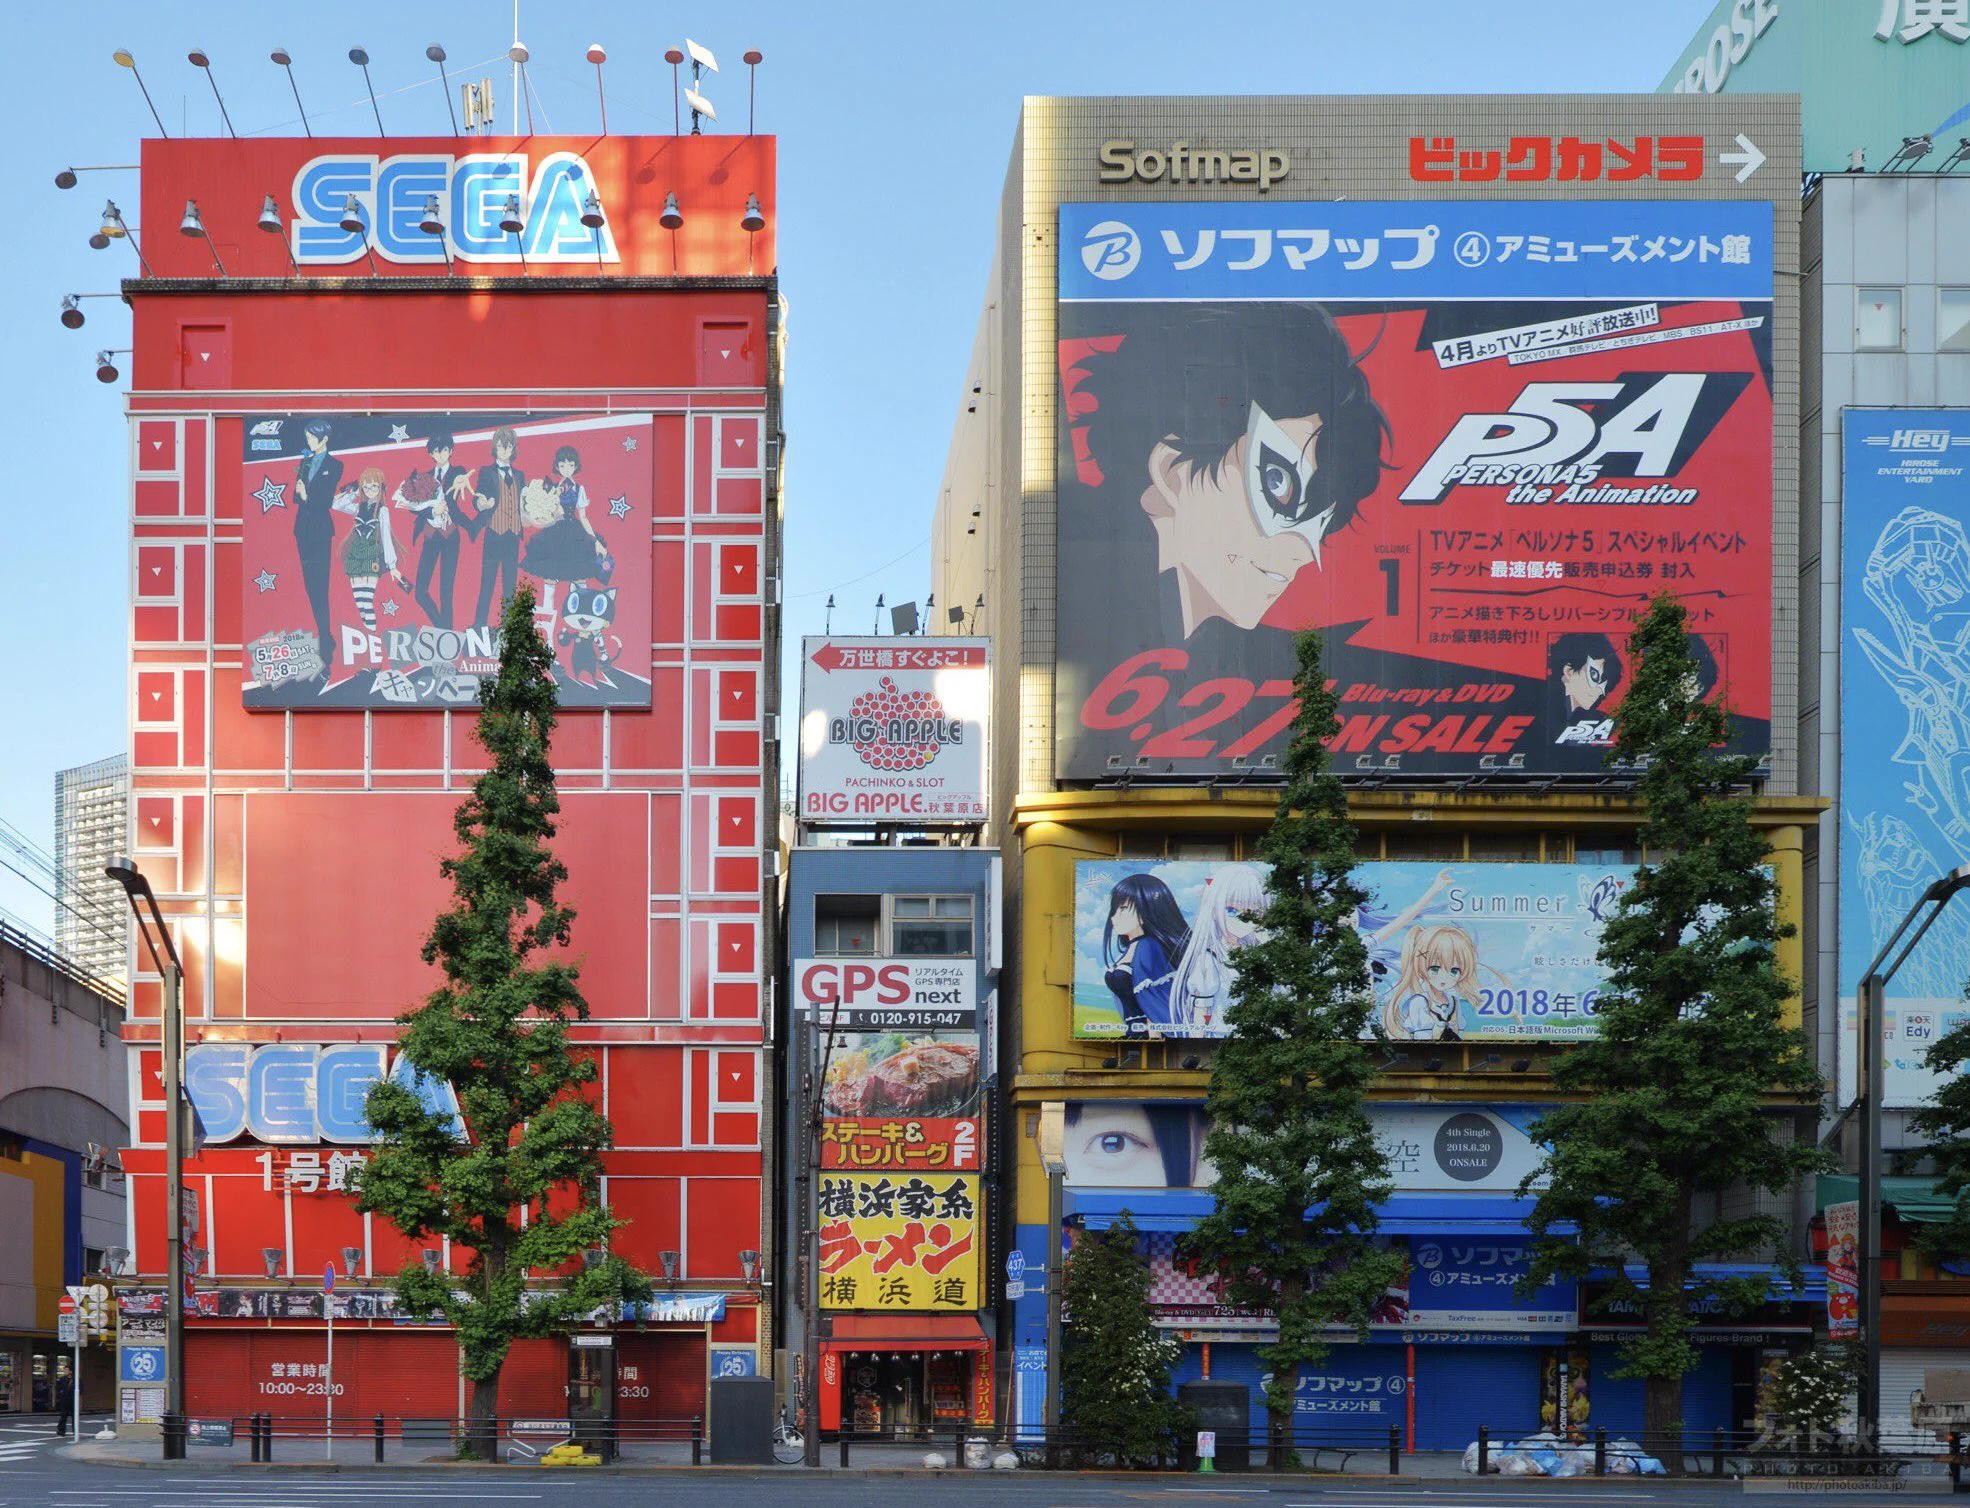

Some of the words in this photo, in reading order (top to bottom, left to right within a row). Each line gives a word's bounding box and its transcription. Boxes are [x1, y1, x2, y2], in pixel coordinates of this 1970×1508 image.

[1100, 140, 1291, 192] Sofmap
[1409, 137, 1704, 181] ビックカメラ
[291, 154, 620, 264] SEGA
[1160, 225, 1440, 270] ソフマップ
[1514, 350, 1546, 362] TOKYO
[1663, 329, 1683, 340] MBS
[1690, 324, 1714, 337] BS11
[1720, 320, 1743, 332] AT-X
[1889, 429, 1951, 453] Hey
[1877, 467, 1964, 476] ENTERTAINMENT
[1901, 459, 1941, 467] HIROSE
[1440, 463, 1605, 486] PERSONA5
[1903, 476, 1934, 484] YARD
[1504, 483, 1548, 504] the
[1562, 482, 1699, 506] Animation
[1373, 544, 1411, 554] VOLUME
[1661, 561, 1695, 579] 封入
[1379, 558, 1400, 617] 1
[433, 661, 456, 676] the
[459, 659, 500, 673] Anima
[839, 649, 969, 668] 万世橋すぐよこ!
[382, 671, 478, 700] キャンペー
[1080, 647, 1338, 759] 6.27
[829, 717, 878, 744] BIG
[884, 717, 963, 744] APPLE
[1379, 714, 1536, 754] SALE
[845, 777, 906, 788] PACHINKO
[908, 779, 915, 788] &
[916, 777, 945, 788] SLOT
[807, 793, 849, 813] BIG
[928, 802, 983, 814] 秋葉原店
[1450, 889, 1567, 913] Summer
[915, 967, 963, 977] リアルタイム
[801, 964, 911, 1005] GPS
[915, 988, 962, 1004] next
[870, 1012, 962, 1025] 0120-915-047
[1906, 1025, 1931, 1039] Edy
[821, 1121, 925, 1143] ステーキ&
[1446, 1127, 1462, 1137] 4th
[1463, 1127, 1491, 1138] Single
[837, 1143, 949, 1165] ハンバーグ
[1446, 1143, 1491, 1152] 2018.6.20
[1449, 1158, 1488, 1167] ONSALE
[820, 1177, 975, 1220] 横浜家系
[820, 1219, 975, 1276] ラーメン
[1007, 1258, 1023, 1271] 437
[822, 1276, 968, 1306] 横浜道
[1418, 1332, 1470, 1342] ソフマップ
[1591, 1332, 1614, 1342] Best
[1689, 1334, 1731, 1344] Figures
[1731, 1334, 1763, 1343] Brand
[1293, 1400, 1381, 1412] ミューズメント館
